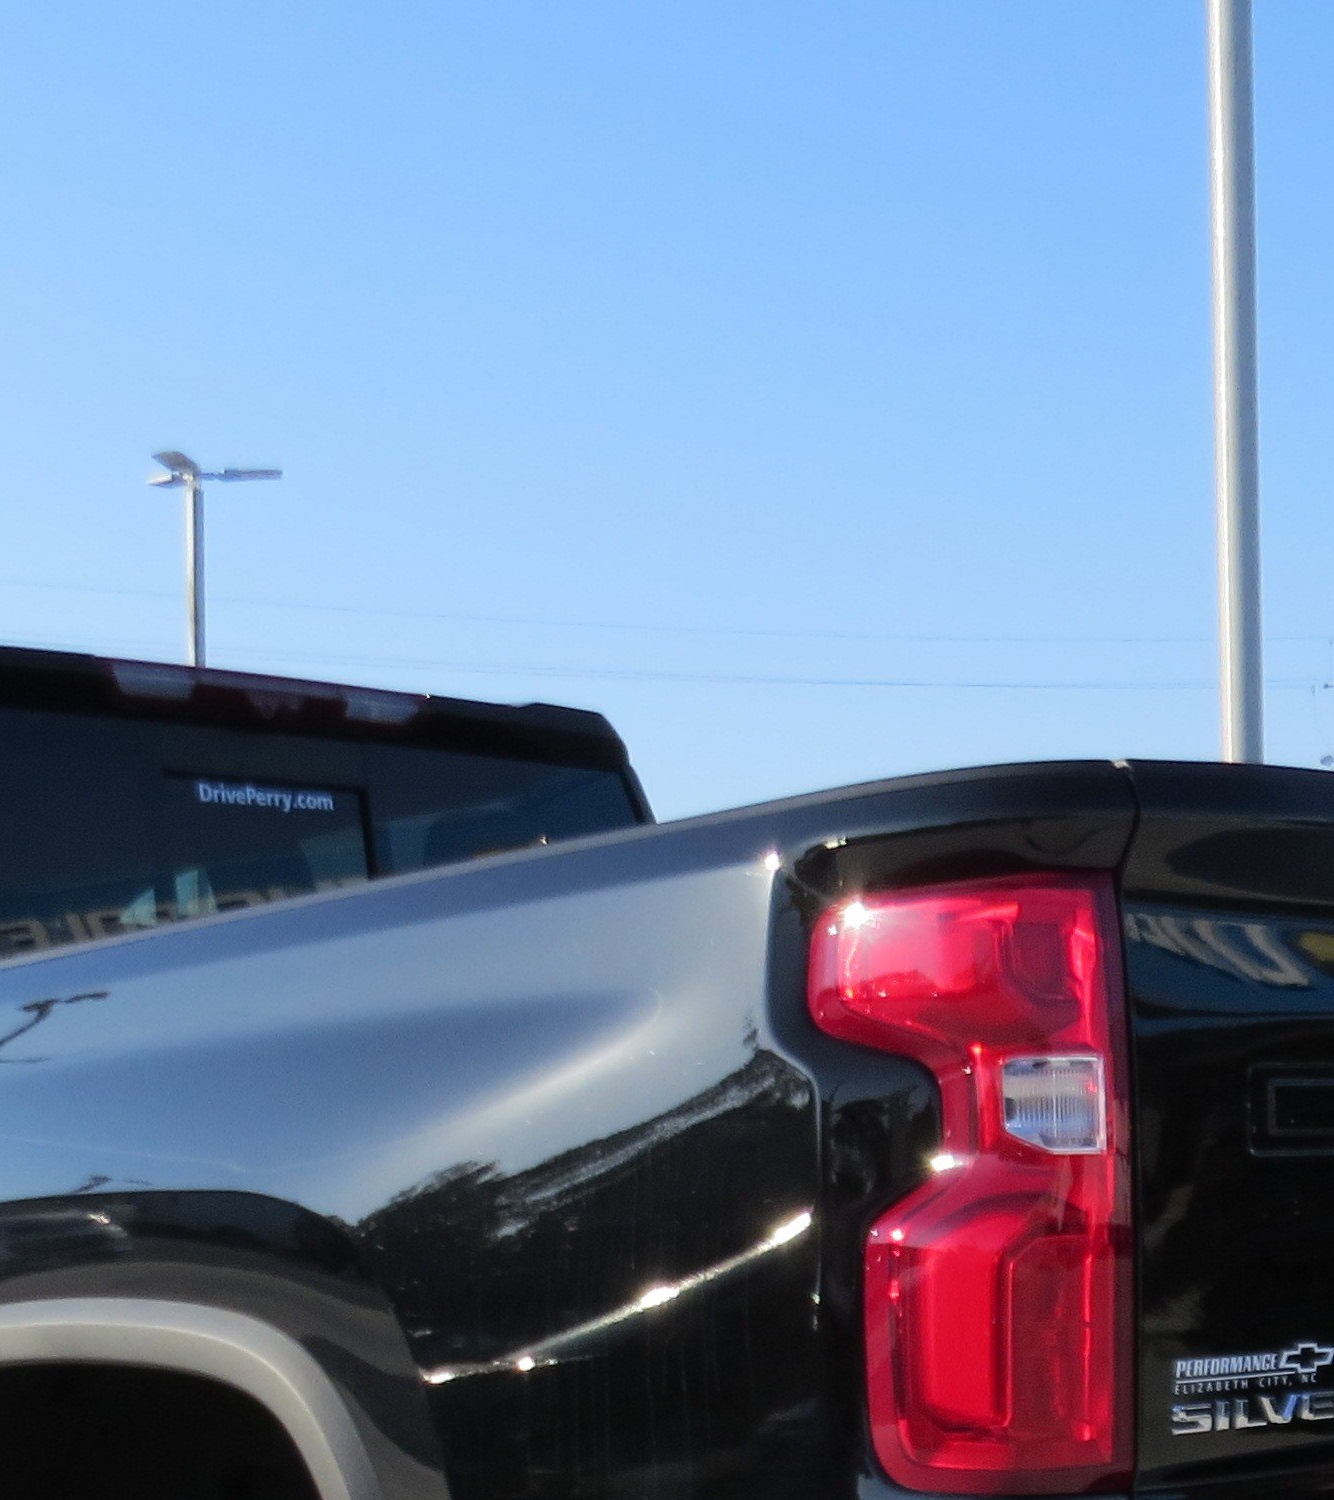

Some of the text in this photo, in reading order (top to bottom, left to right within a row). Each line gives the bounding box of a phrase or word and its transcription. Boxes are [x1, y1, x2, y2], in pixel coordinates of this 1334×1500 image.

[197, 782, 335, 812] DrivePerry.com
[1175, 1353, 1279, 1379] PERFORMANCE
[1175, 1379, 1249, 1395] ELIZABETH
[1300, 1372, 1318, 1384] NC
